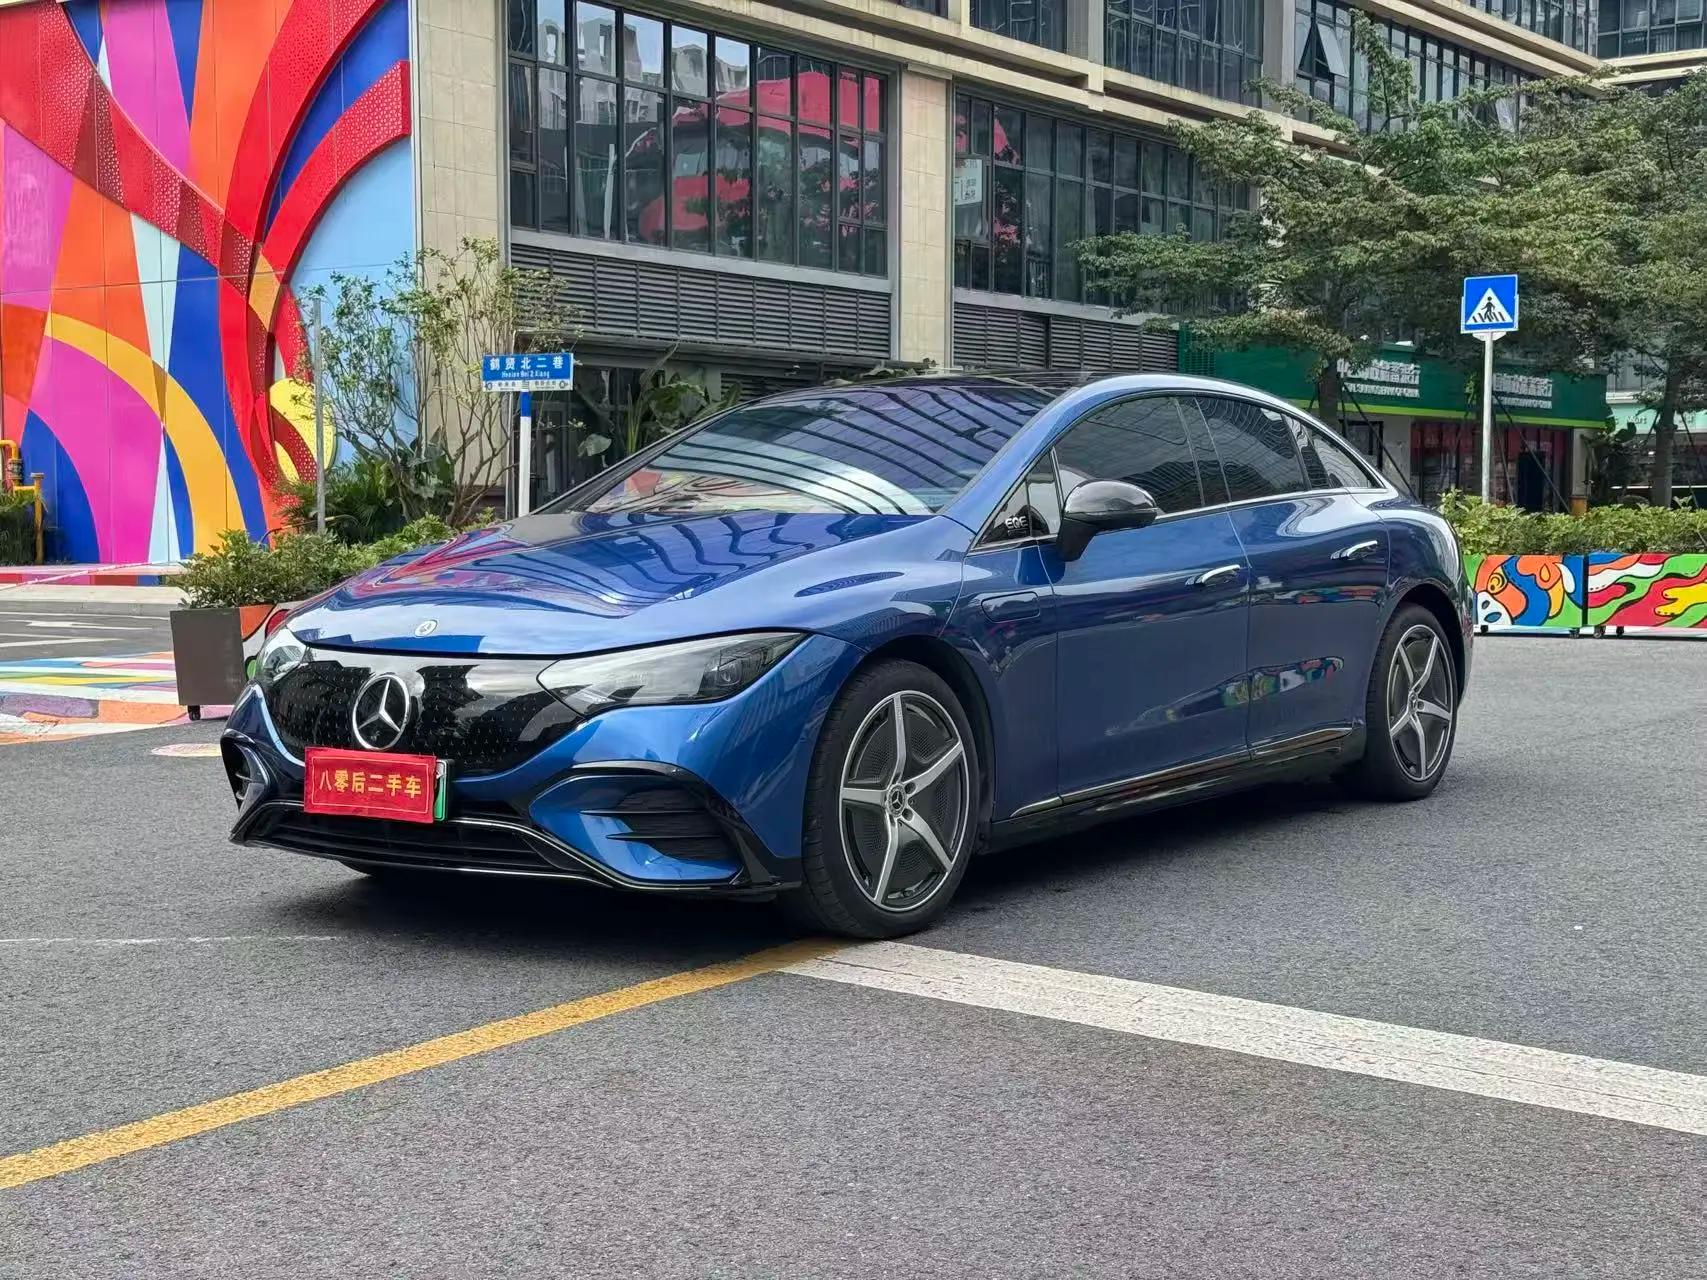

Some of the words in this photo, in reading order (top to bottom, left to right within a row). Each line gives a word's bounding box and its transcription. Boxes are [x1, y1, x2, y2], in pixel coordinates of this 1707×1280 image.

[1005, 515, 1028, 529] EQE
[319, 769, 422, 799] 八零后二手车
